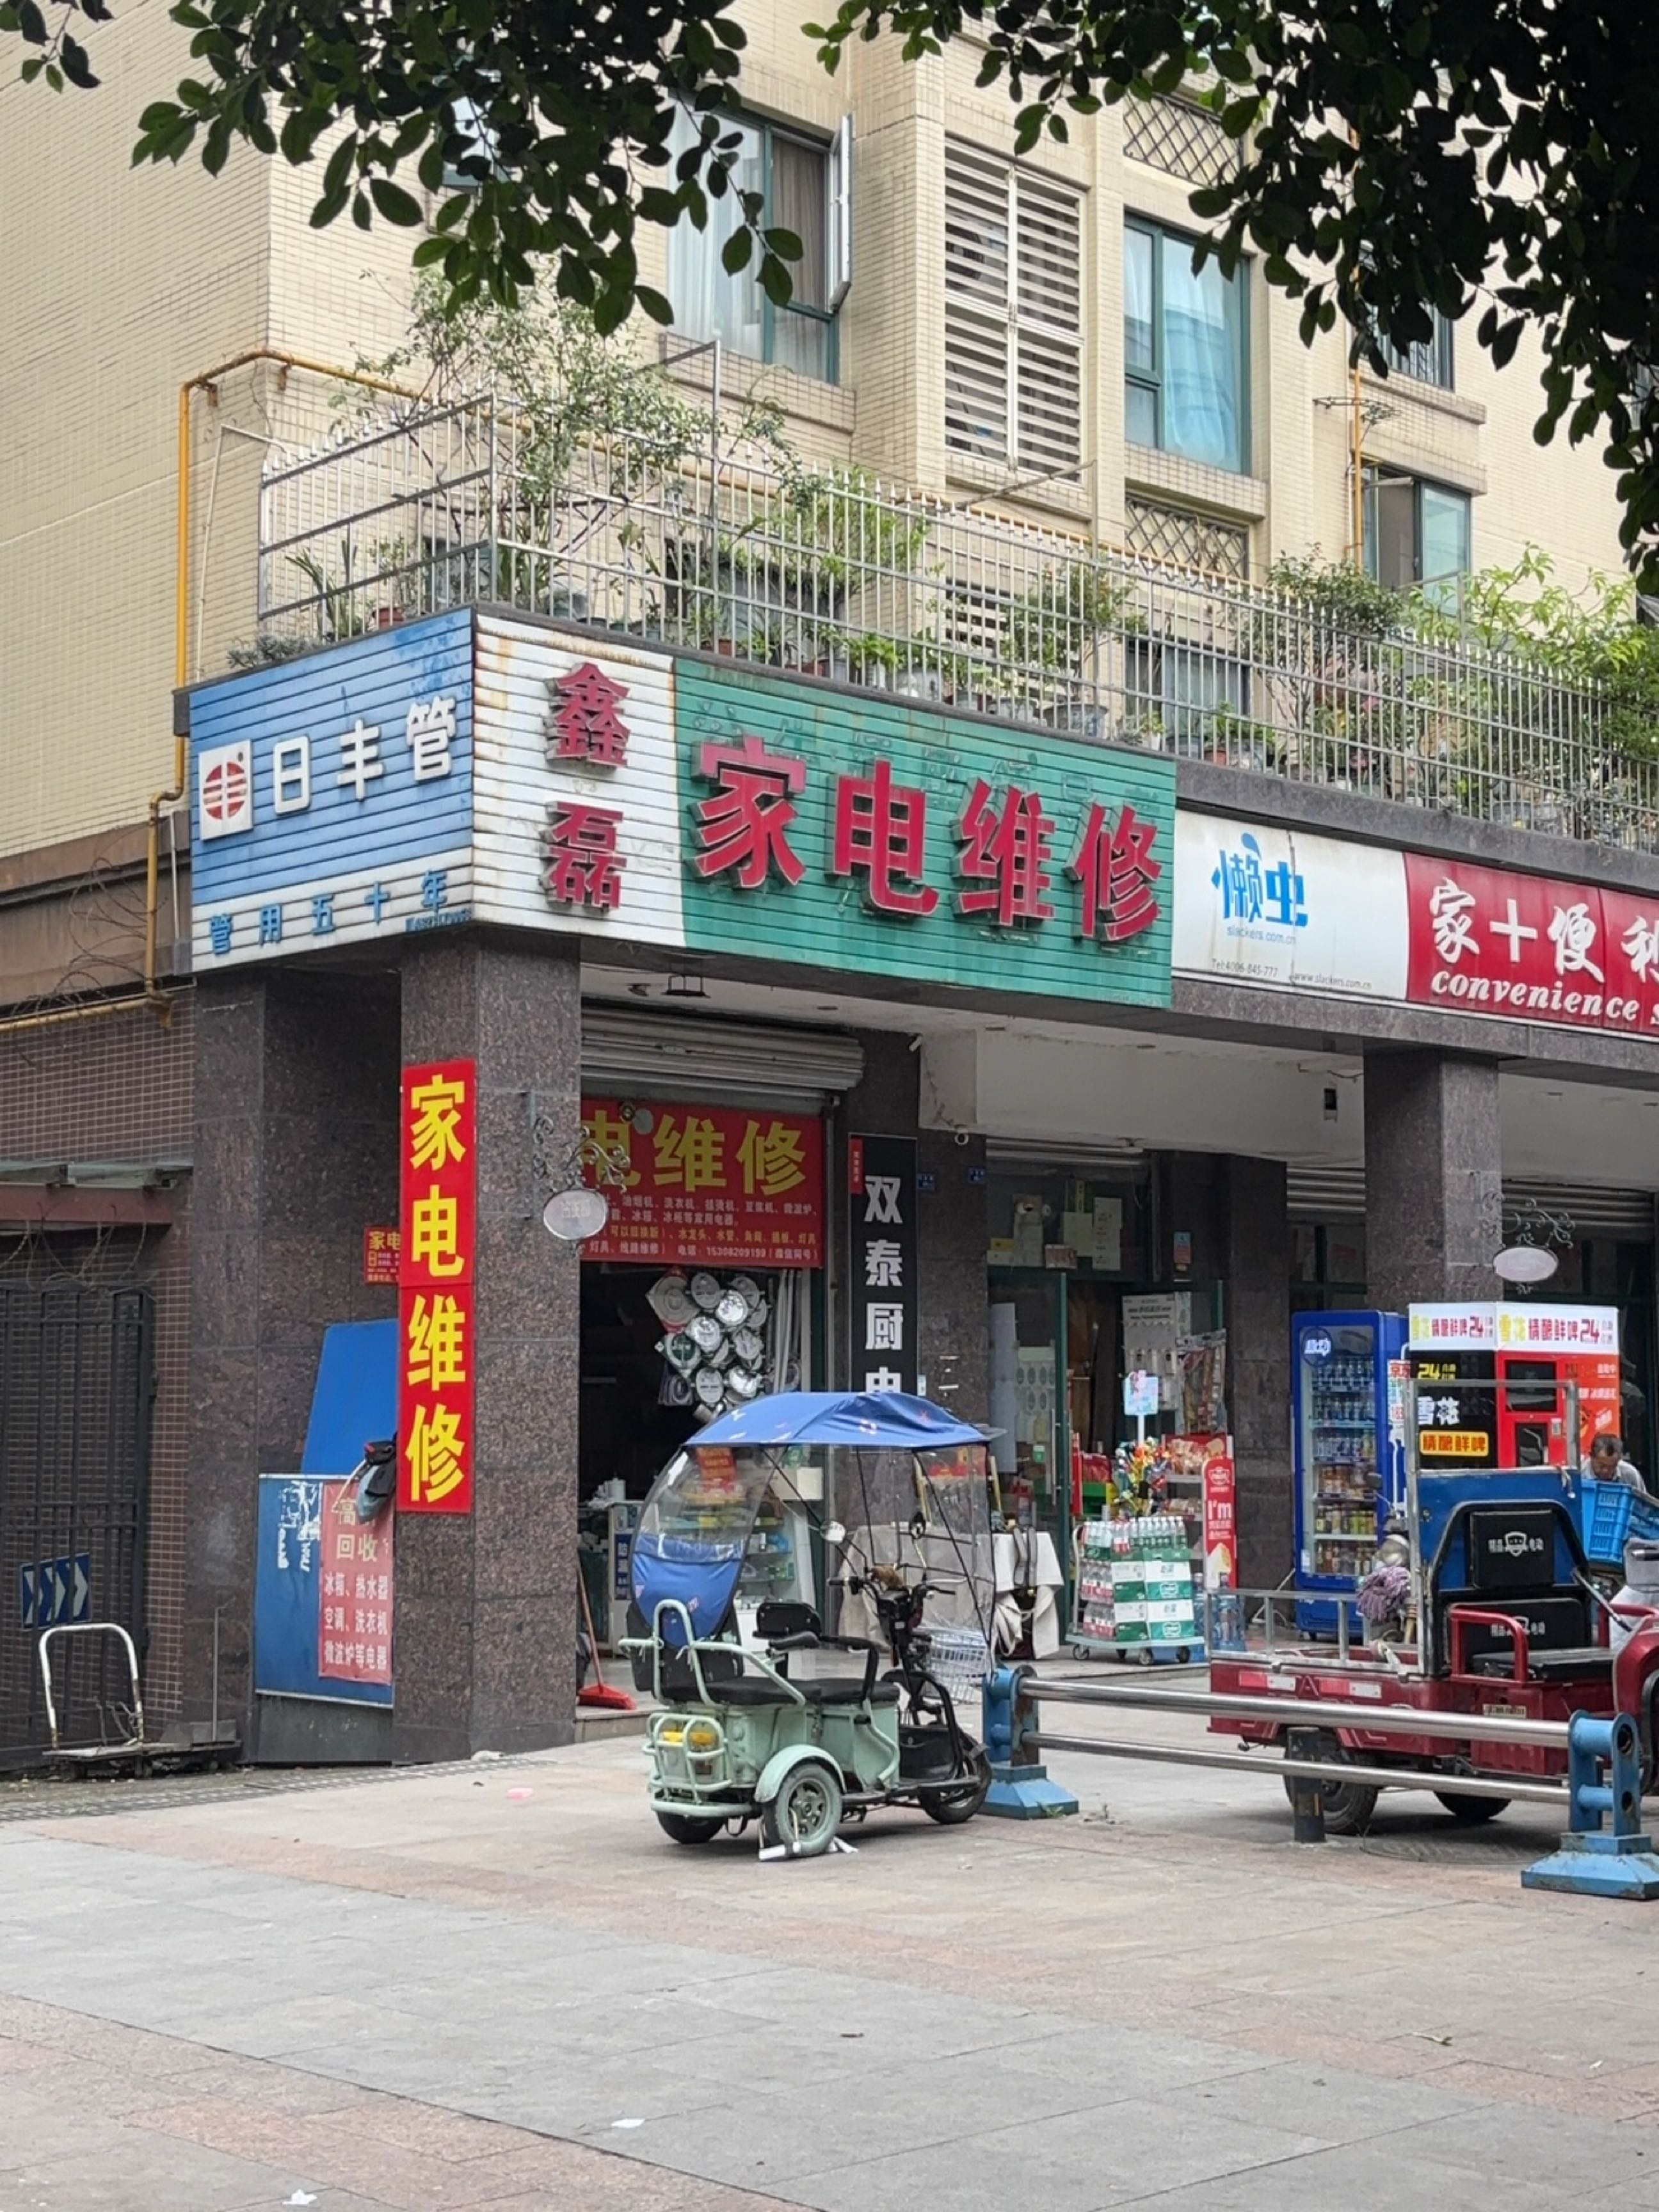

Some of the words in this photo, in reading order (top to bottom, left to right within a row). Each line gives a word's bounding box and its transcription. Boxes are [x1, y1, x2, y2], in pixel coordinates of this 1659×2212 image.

[273, 696, 456, 815] 日丰管
[548, 662, 630, 913] 鑫磊
[689, 735, 1163, 942] 家电维修
[210, 869, 447, 954] 管用五十年
[1212, 838, 1308, 928] 懒虫
[1227, 926, 1296, 945] slackers.com.cn
[1432, 971, 1640, 1021] convenience
[406, 1074, 466, 1503] 家电维修
[1418, 1396, 1460, 1425] 雪花
[337, 1534, 378, 1562] 回收
[339, 1498, 375, 1526] 高
